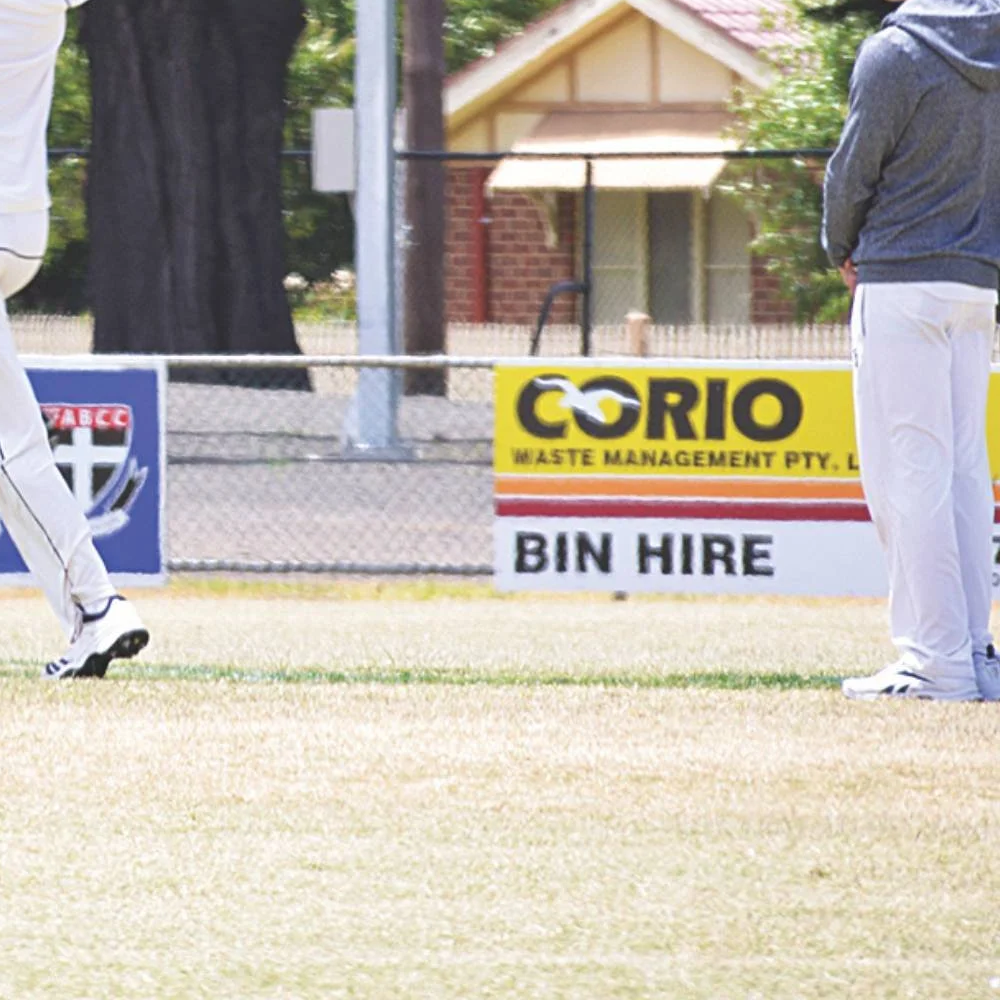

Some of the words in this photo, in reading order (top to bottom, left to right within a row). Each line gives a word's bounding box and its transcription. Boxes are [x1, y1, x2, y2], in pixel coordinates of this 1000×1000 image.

[516, 374, 804, 443] CORIO
[511, 446, 595, 469] WASTE
[603, 448, 774, 471] MANAGEMENT
[783, 450, 840, 472] PTY.
[514, 530, 613, 575] BIN
[637, 533, 776, 577] HIRE
